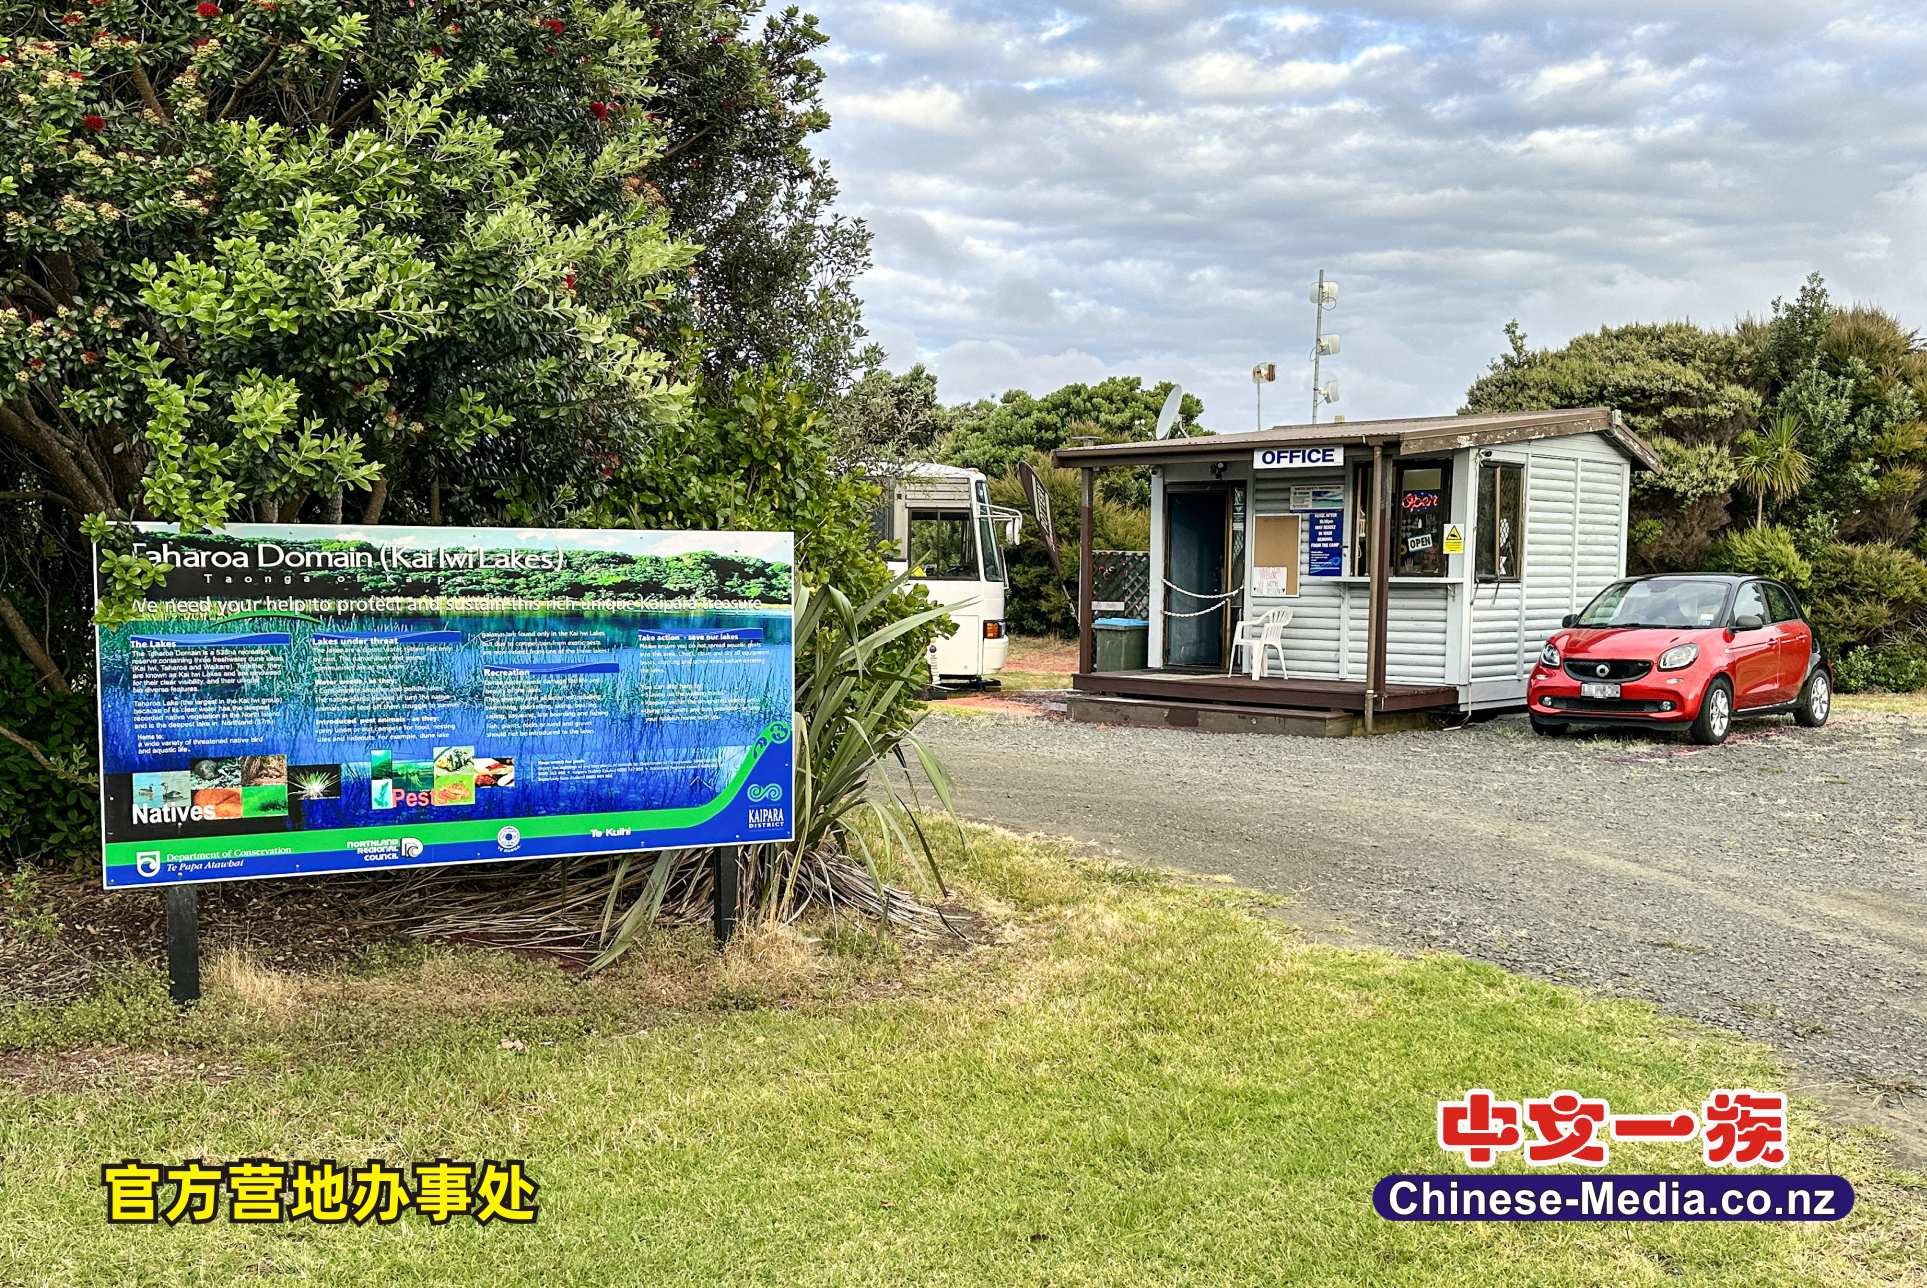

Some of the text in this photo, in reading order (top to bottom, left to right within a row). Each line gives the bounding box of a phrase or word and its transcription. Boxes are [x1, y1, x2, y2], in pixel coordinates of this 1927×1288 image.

[1262, 448, 1335, 464] OFFICE
[1402, 494, 1438, 512] Open
[1410, 536, 1431, 549] OPEN
[132, 542, 564, 572] Taharoa Domain (Kai Iwi Lakes)
[204, 573, 311, 584] Taonga
[165, 596, 211, 612] need
[217, 599, 263, 616] your
[266, 596, 306, 614] help
[313, 598, 331, 612] to
[337, 599, 401, 615] protect
[407, 595, 440, 611] and
[446, 597, 505, 611] sustain
[512, 597, 540, 610] this
[546, 596, 575, 610] rich
[582, 597, 635, 613] unique
[641, 597, 696, 613] Kaipara
[484, 668, 530, 676] Recreation
[392, 788, 448, 807] Pests
[132, 802, 217, 825] Natives
[748, 808, 784, 823] KAIPARA
[590, 829, 603, 838] Te
[347, 838, 399, 848] NORTHLAND
[356, 846, 399, 854] REGIONAL
[166, 846, 292, 864] Department of Conservation
[166, 862, 178, 872] Te
[179, 862, 203, 872] Papa
